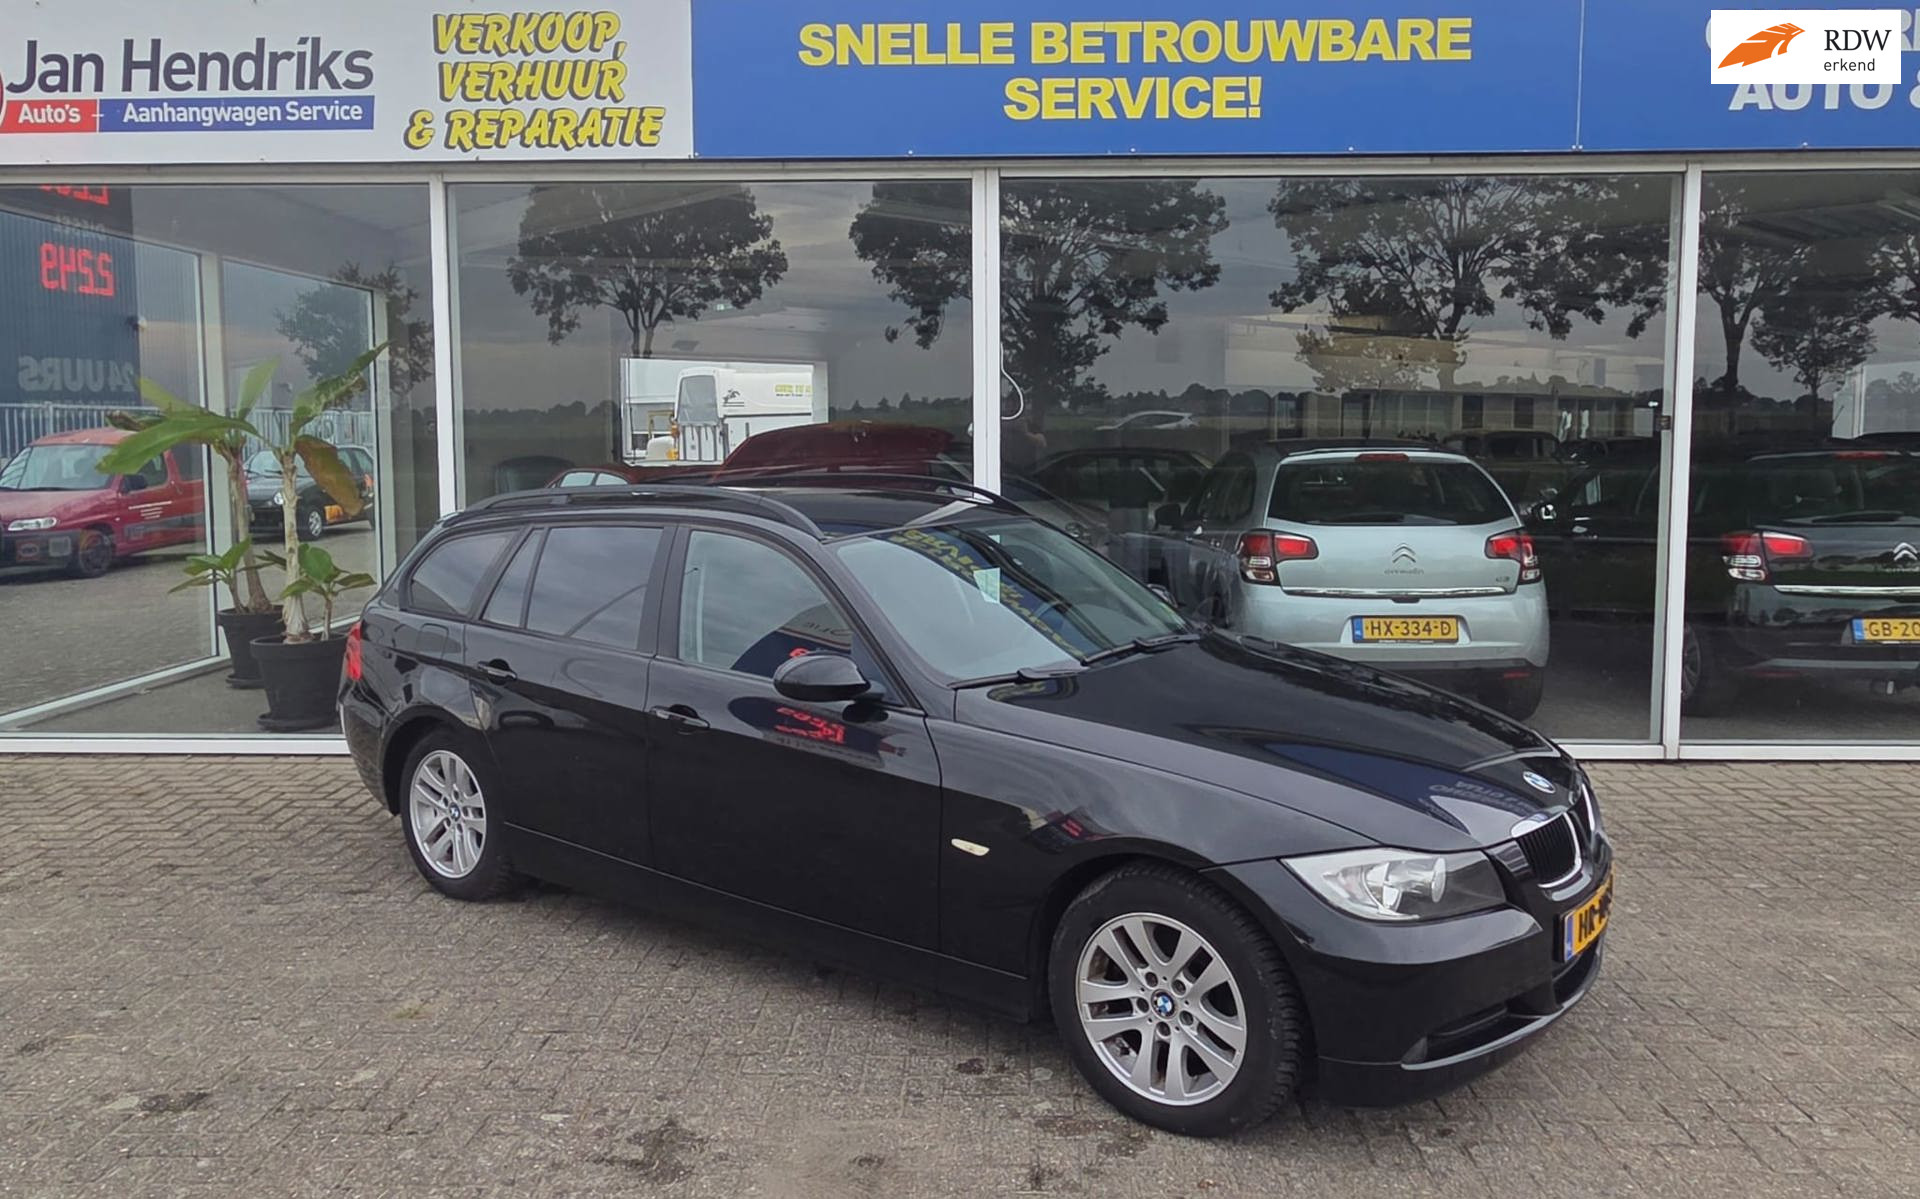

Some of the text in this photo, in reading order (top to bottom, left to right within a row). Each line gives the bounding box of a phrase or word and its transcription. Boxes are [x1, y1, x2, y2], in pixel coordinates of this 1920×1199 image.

[433, 11, 627, 59] VERKOOP,
[798, 17, 1472, 66] SNELLE BETROUWBARE
[6, 40, 104, 93] Jan
[438, 59, 627, 105] VERHUUR
[18, 103, 81, 124] Auto's
[123, 101, 281, 126] Aanhangwagen
[285, 99, 364, 122] Service
[1003, 76, 1262, 120] SERVICE!
[1728, 83, 1894, 110] AUTO
[403, 106, 666, 152] & REPARATIE
[1370, 621, 1451, 636] HX-334-D
